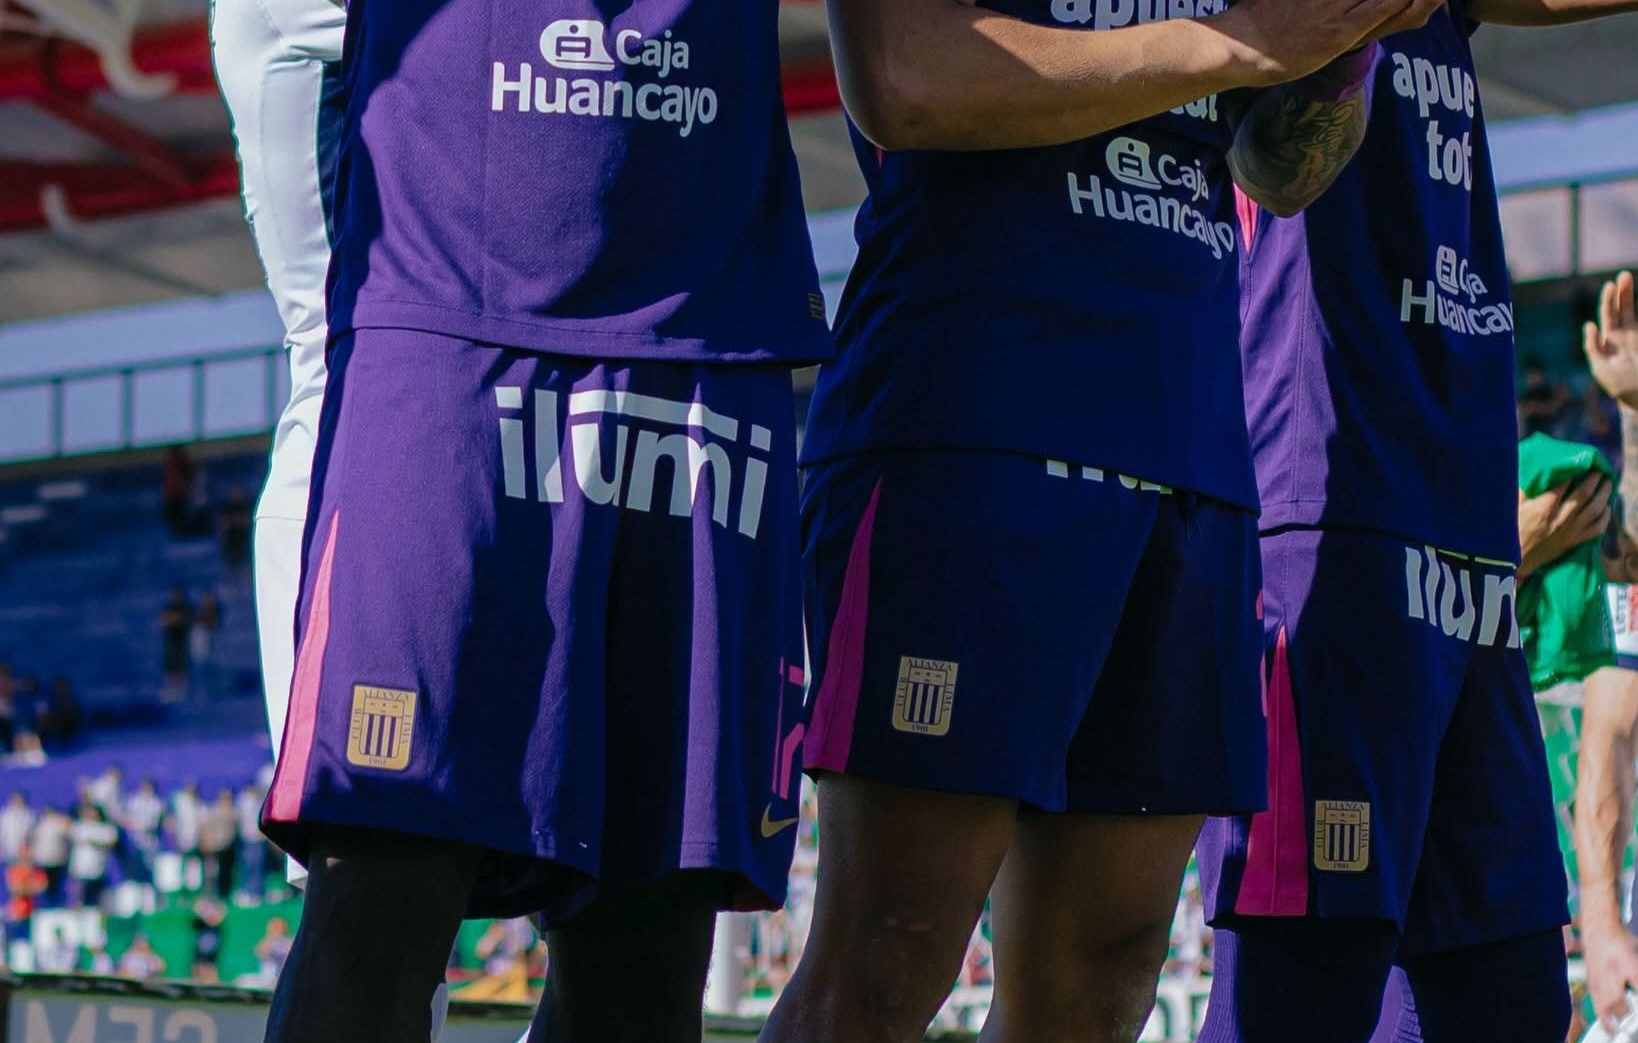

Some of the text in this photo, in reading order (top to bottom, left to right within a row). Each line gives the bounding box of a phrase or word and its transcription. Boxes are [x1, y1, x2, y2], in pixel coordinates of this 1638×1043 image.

[616, 29, 689, 78] Caja
[491, 62, 718, 138] Huancayo
[1066, 171, 1235, 260] Huancayo
[1157, 154, 1209, 202] Caja
[494, 386, 772, 540] ilumi
